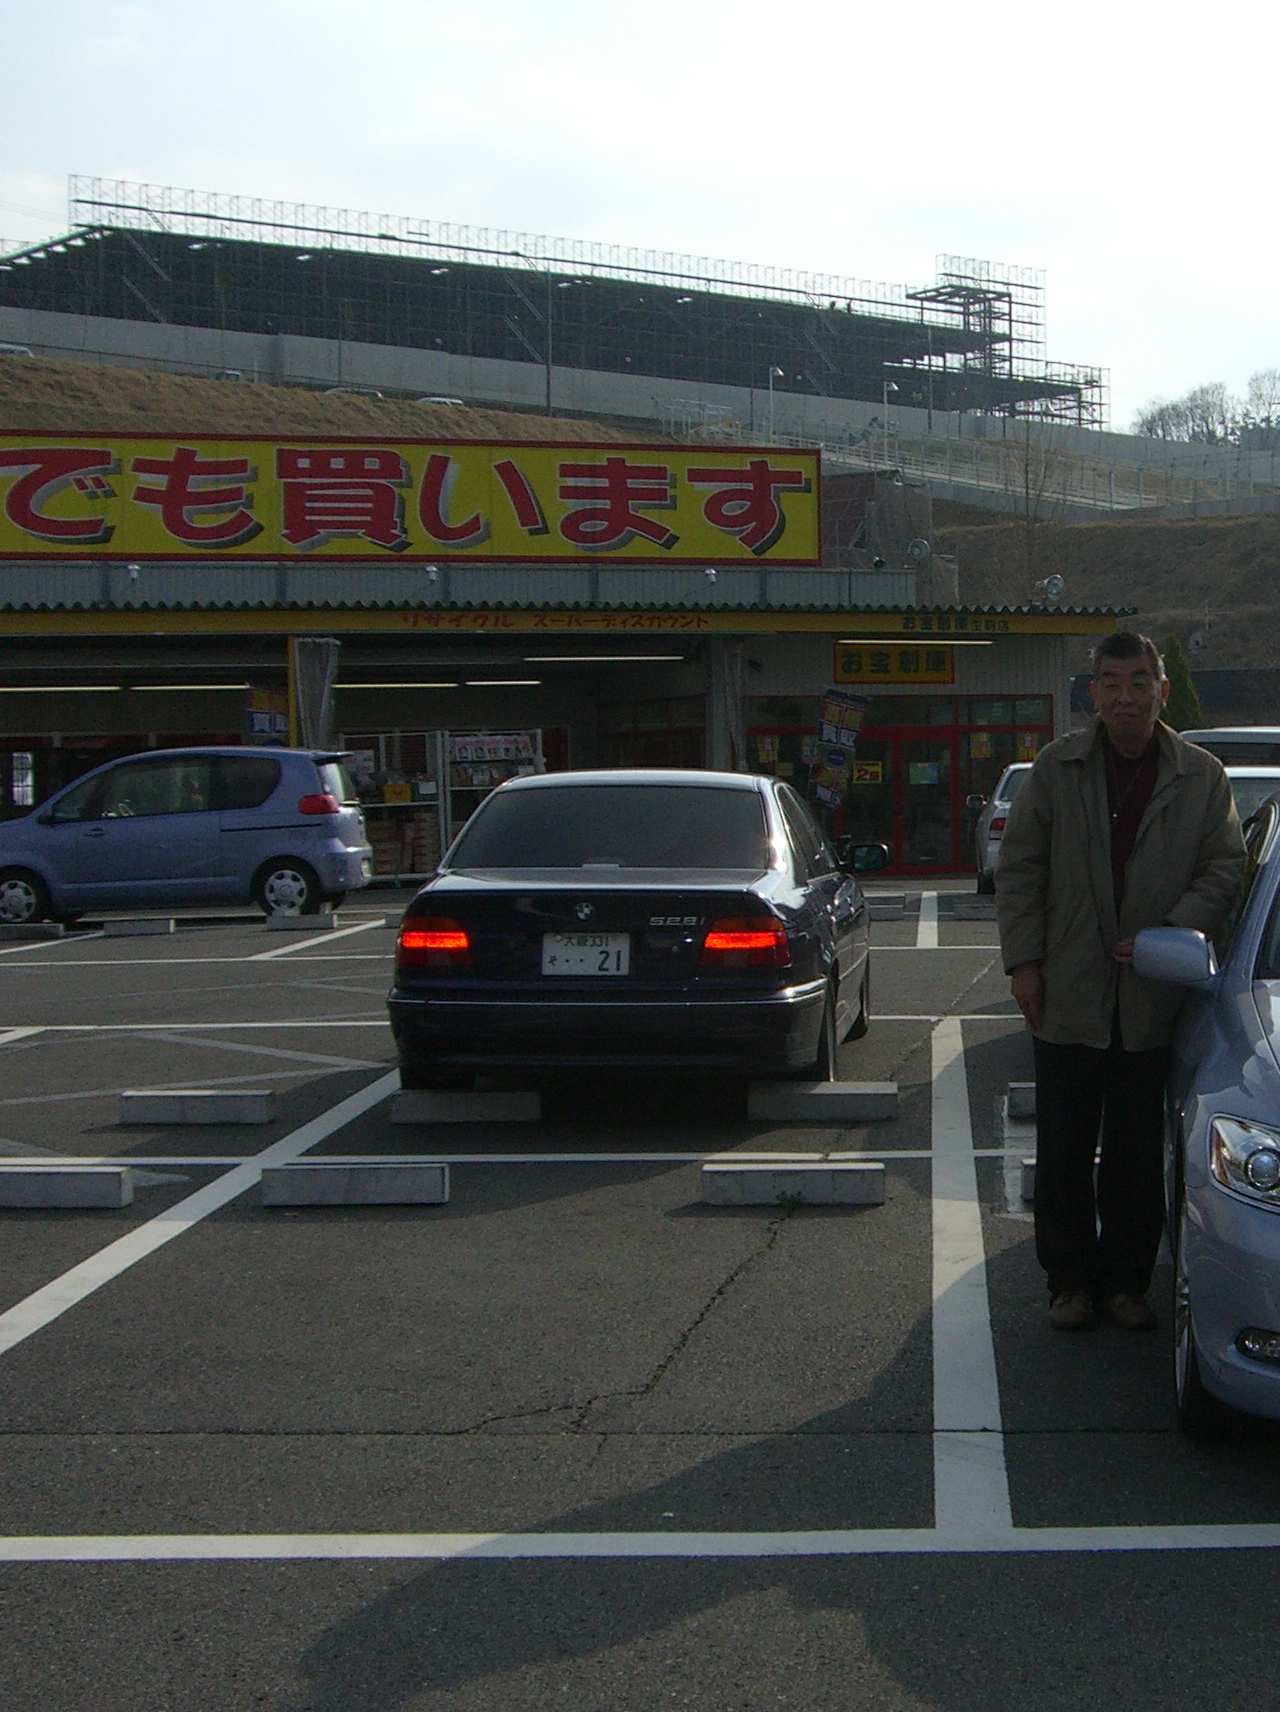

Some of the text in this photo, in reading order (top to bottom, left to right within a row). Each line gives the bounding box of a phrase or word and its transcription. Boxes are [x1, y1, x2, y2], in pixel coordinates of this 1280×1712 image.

[0, 447, 810, 555] でも買います
[402, 611, 514, 629] リサイクル
